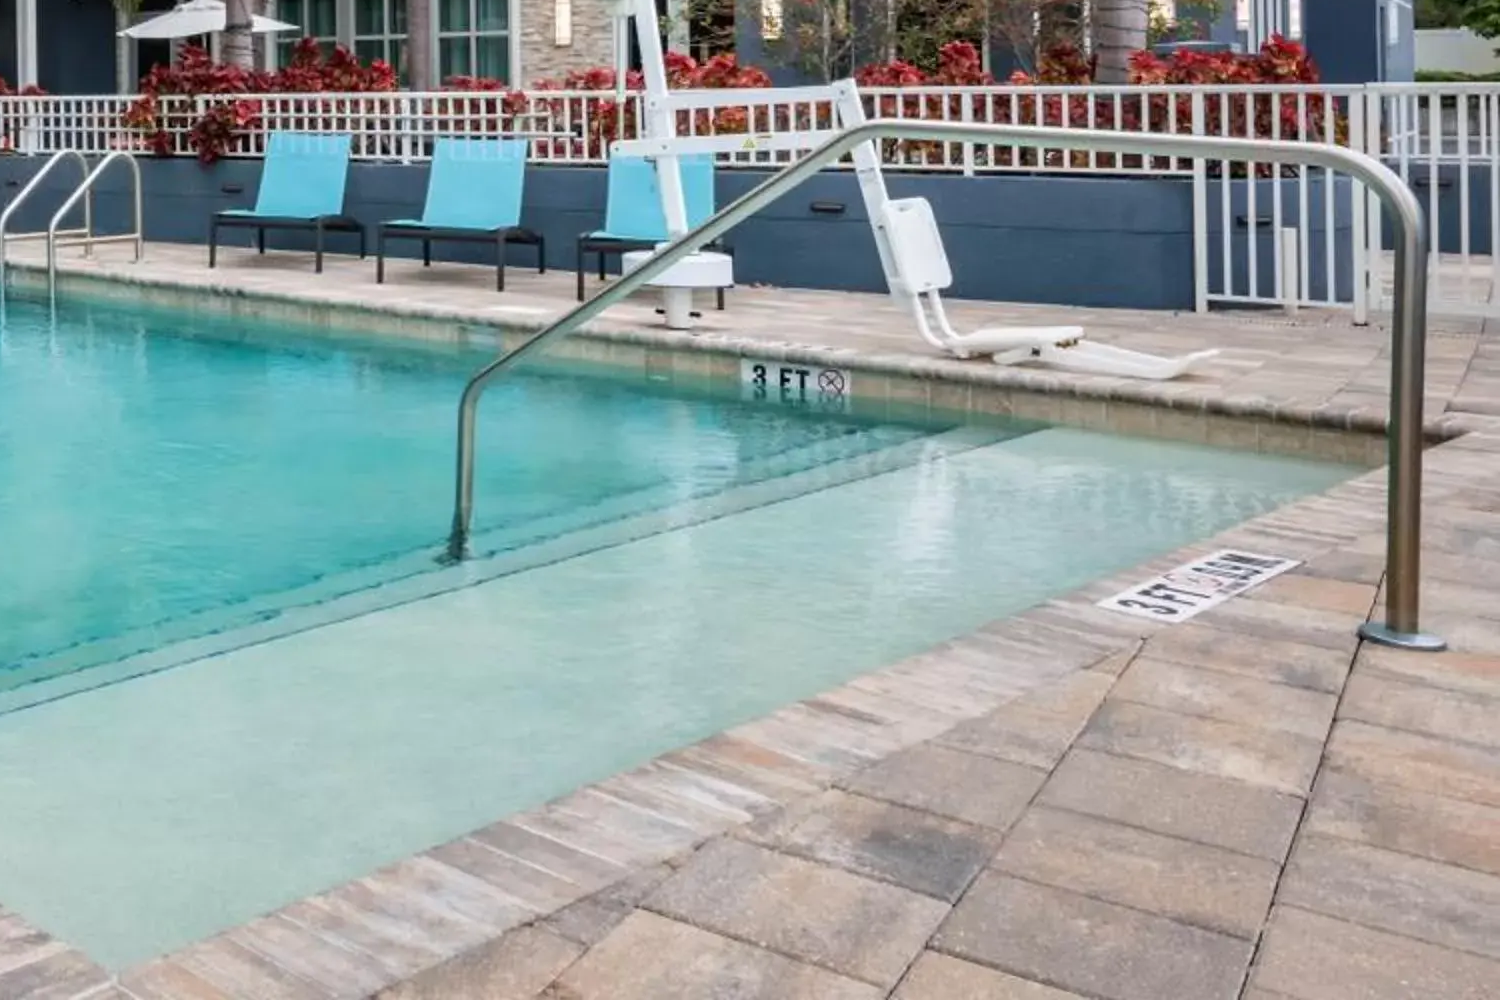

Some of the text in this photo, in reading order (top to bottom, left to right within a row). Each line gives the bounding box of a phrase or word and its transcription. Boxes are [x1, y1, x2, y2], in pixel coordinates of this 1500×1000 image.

[752, 364, 810, 389] 3 FT
[1136, 583, 1211, 606] FT
[1116, 599, 1179, 615] 3
